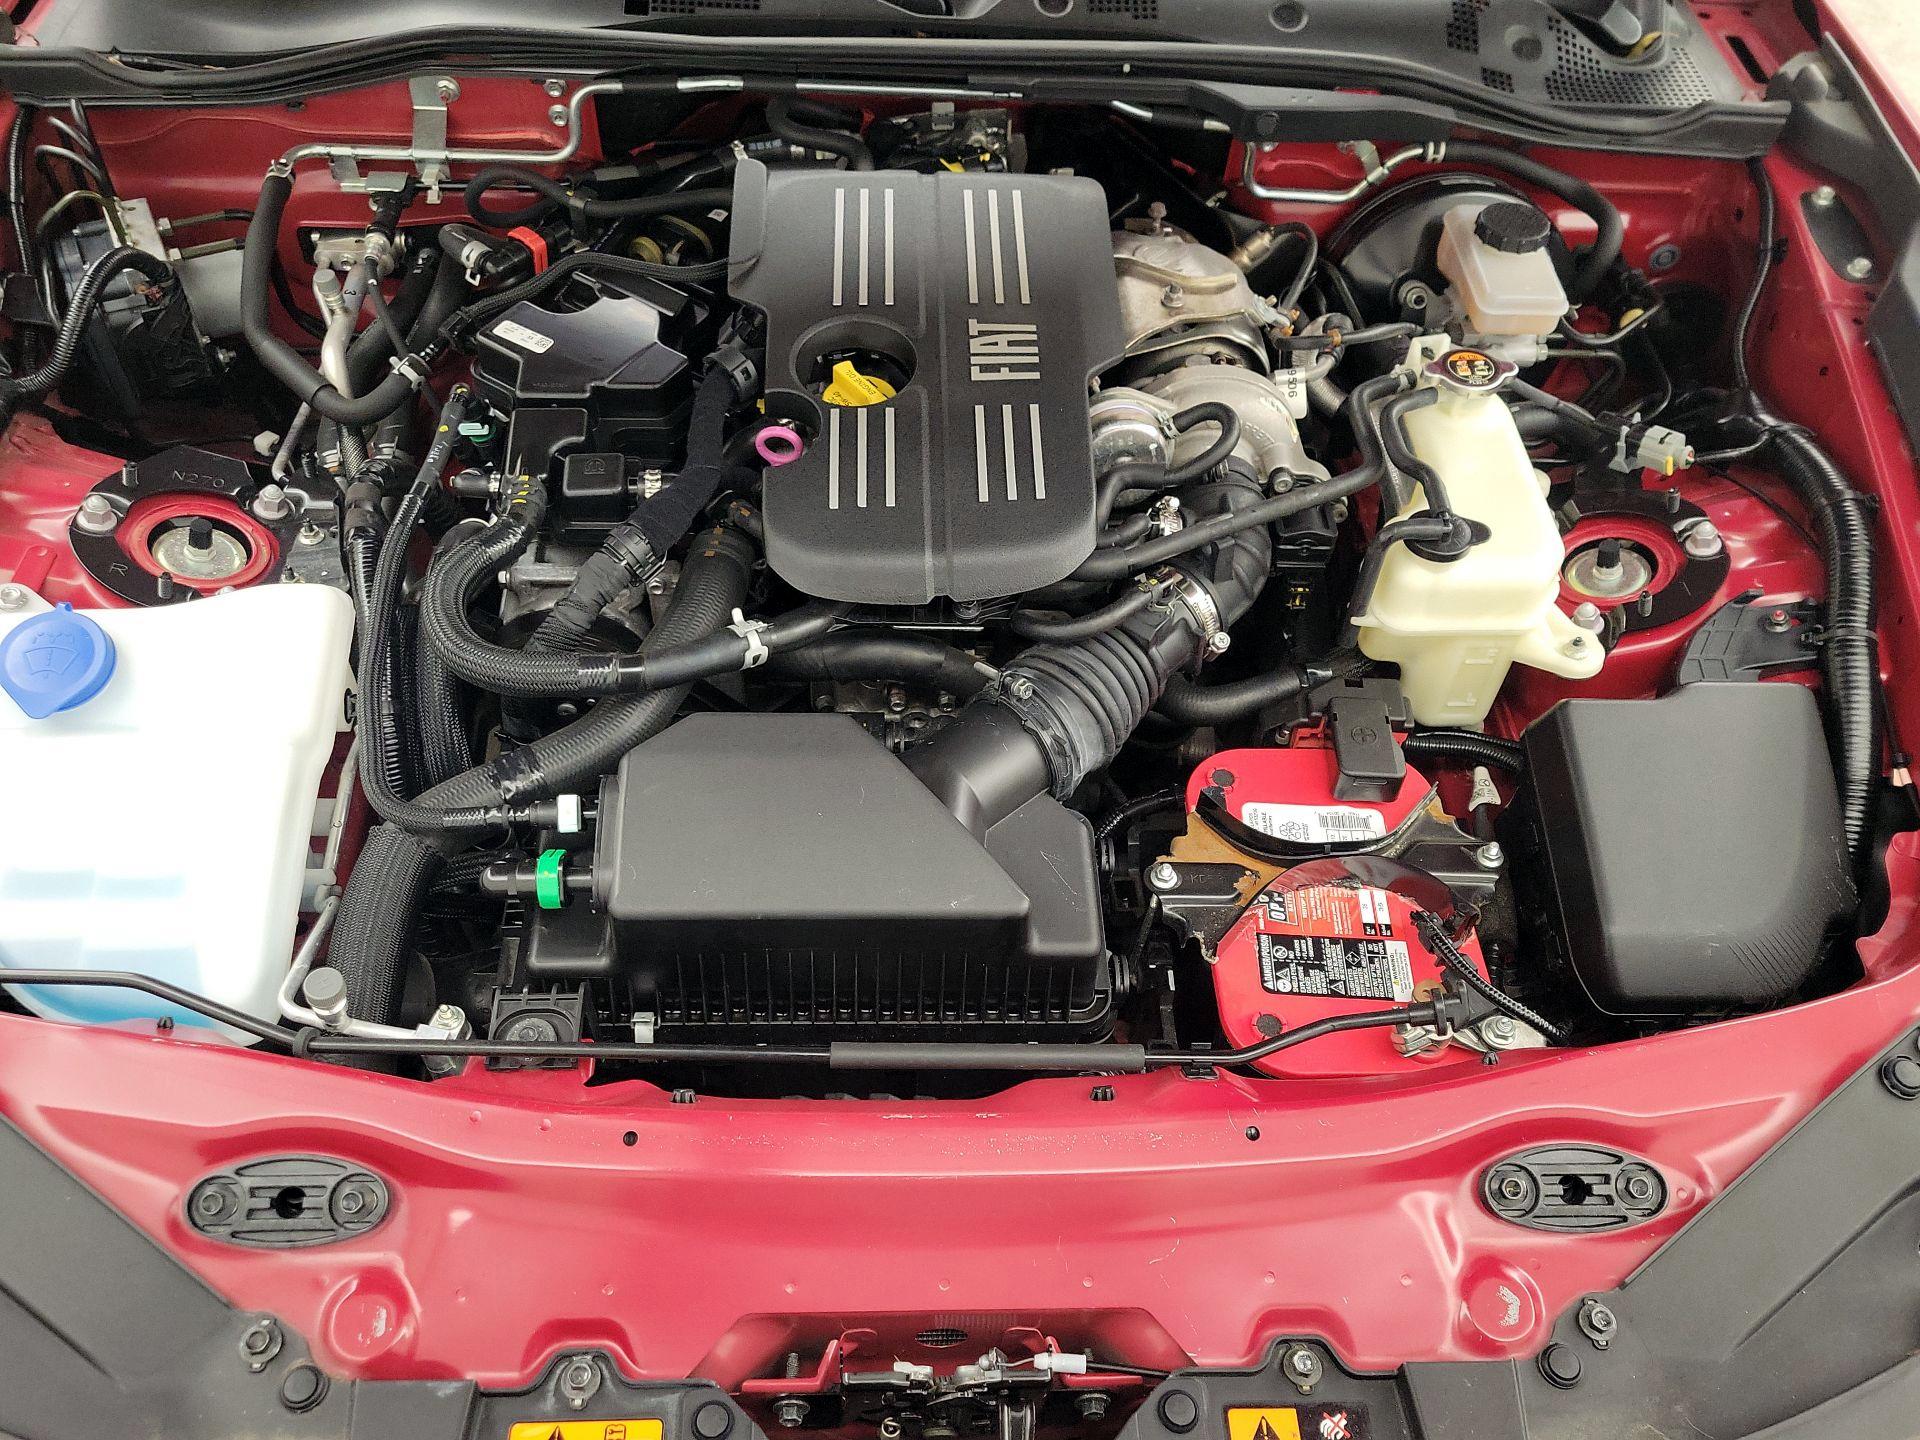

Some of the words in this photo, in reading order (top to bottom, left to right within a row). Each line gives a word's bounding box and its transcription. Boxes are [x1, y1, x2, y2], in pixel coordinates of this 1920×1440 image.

[969, 318, 1040, 382] FIAT
[853, 377, 876, 396] ENGINE
[1287, 369, 1298, 398] 9506
[171, 468, 225, 488] N270
[109, 562, 128, 577] R
[1260, 934, 1272, 980] DANGER/POISON
